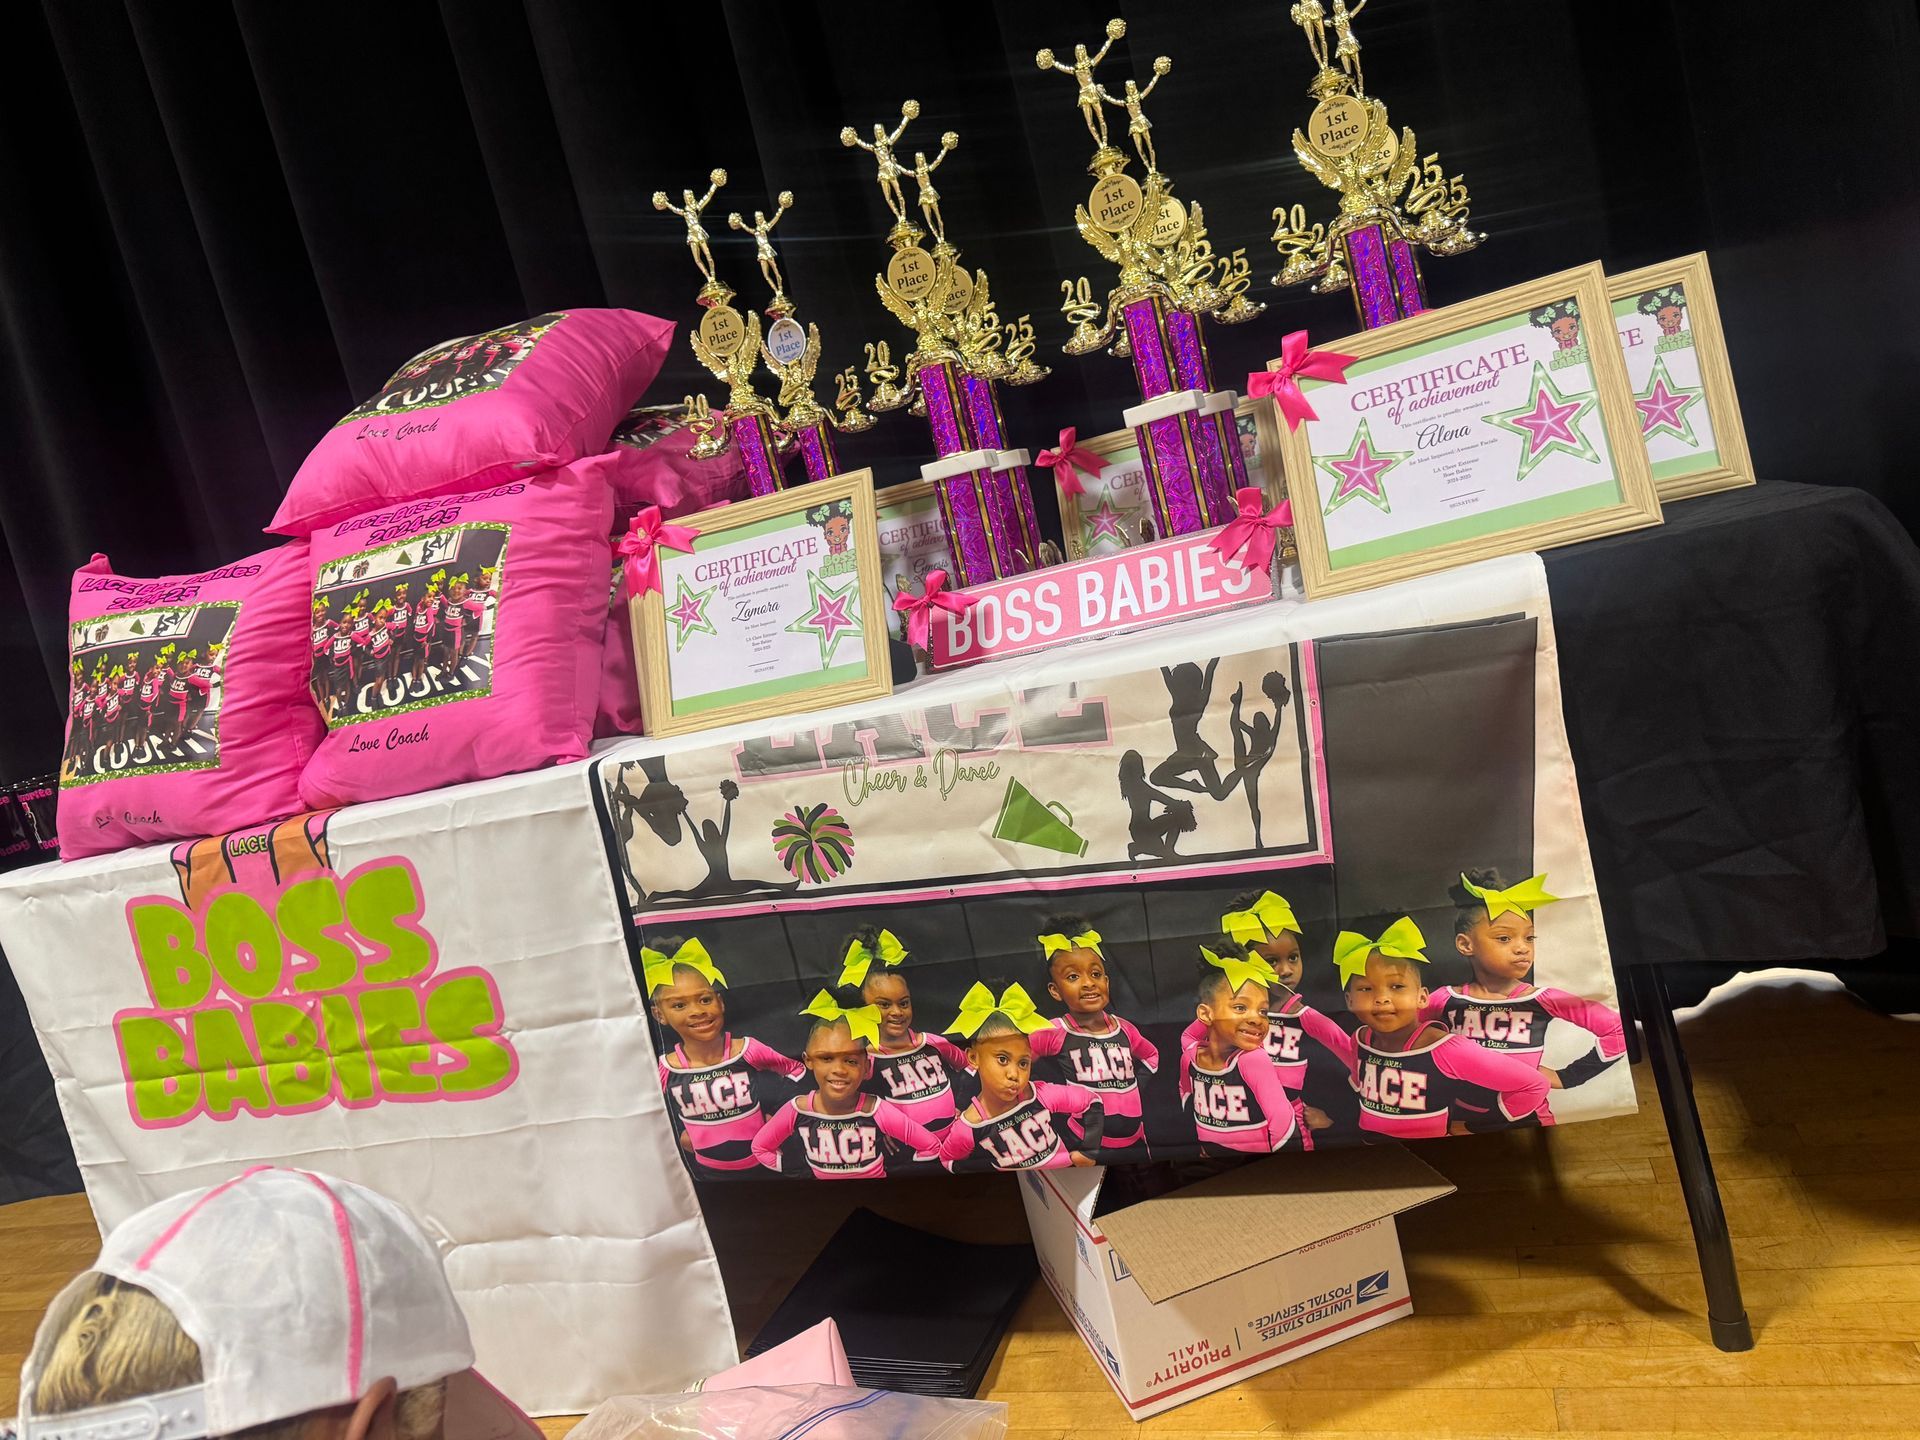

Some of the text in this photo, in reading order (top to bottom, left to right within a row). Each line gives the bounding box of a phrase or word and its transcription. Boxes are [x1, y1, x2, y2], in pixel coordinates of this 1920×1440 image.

[1325, 110, 1349, 127] 1st
[1319, 124, 1359, 145] Place
[1103, 187, 1125, 204] 1st
[1100, 200, 1136, 221] Place
[1159, 209, 1171, 220] st
[1271, 204, 1307, 240] 20
[901, 259, 920, 274] 1st
[896, 273, 929, 290] Place
[1061, 276, 1092, 312] 20
[948, 289, 967, 303] ace
[709, 328, 738, 346] Place
[712, 318, 729, 332] 1st
[778, 330, 794, 342] 1st
[775, 340, 801, 356] Place
[864, 340, 890, 372] 20
[1350, 343, 1529, 412] CERTIFICATE
[1387, 370, 1500, 425] of achievement
[356, 418, 438, 440] Love Coach
[1416, 424, 1471, 449] Alena
[334, 512, 393, 537] LACE
[365, 506, 461, 546] 2024-25
[694, 536, 818, 582] CERTIFICATE
[79, 578, 141, 594] LACE
[718, 572, 731, 597] of
[734, 557, 797, 588] achievement
[731, 599, 780, 622] Zamora
[948, 543, 1252, 657] BOSS BABIES
[349, 723, 429, 752] Love Coach
[842, 747, 1001, 807] Cheer & Dance
[229, 834, 268, 857] LACE
[127, 857, 437, 1011] BOSS
[1468, 1003, 1513, 1012] Jesse Owens
[1448, 1005, 1533, 1045] LACE
[114, 969, 517, 1128] BABIES
[1263, 1023, 1304, 1060] CE
[1488, 1040, 1510, 1049] Dance
[880, 1054, 948, 1097] LACE
[1069, 1046, 1136, 1082] LACE
[670, 1071, 753, 1118] LACE
[1193, 1080, 1250, 1122] ACE
[798, 1126, 876, 1163] LACE
[979, 1109, 1057, 1168] LACE
[1307, 1284, 1352, 1311] POSTAL
[1262, 1299, 1352, 1342] UNITED STATES
[1168, 1338, 1210, 1363] MAIL
